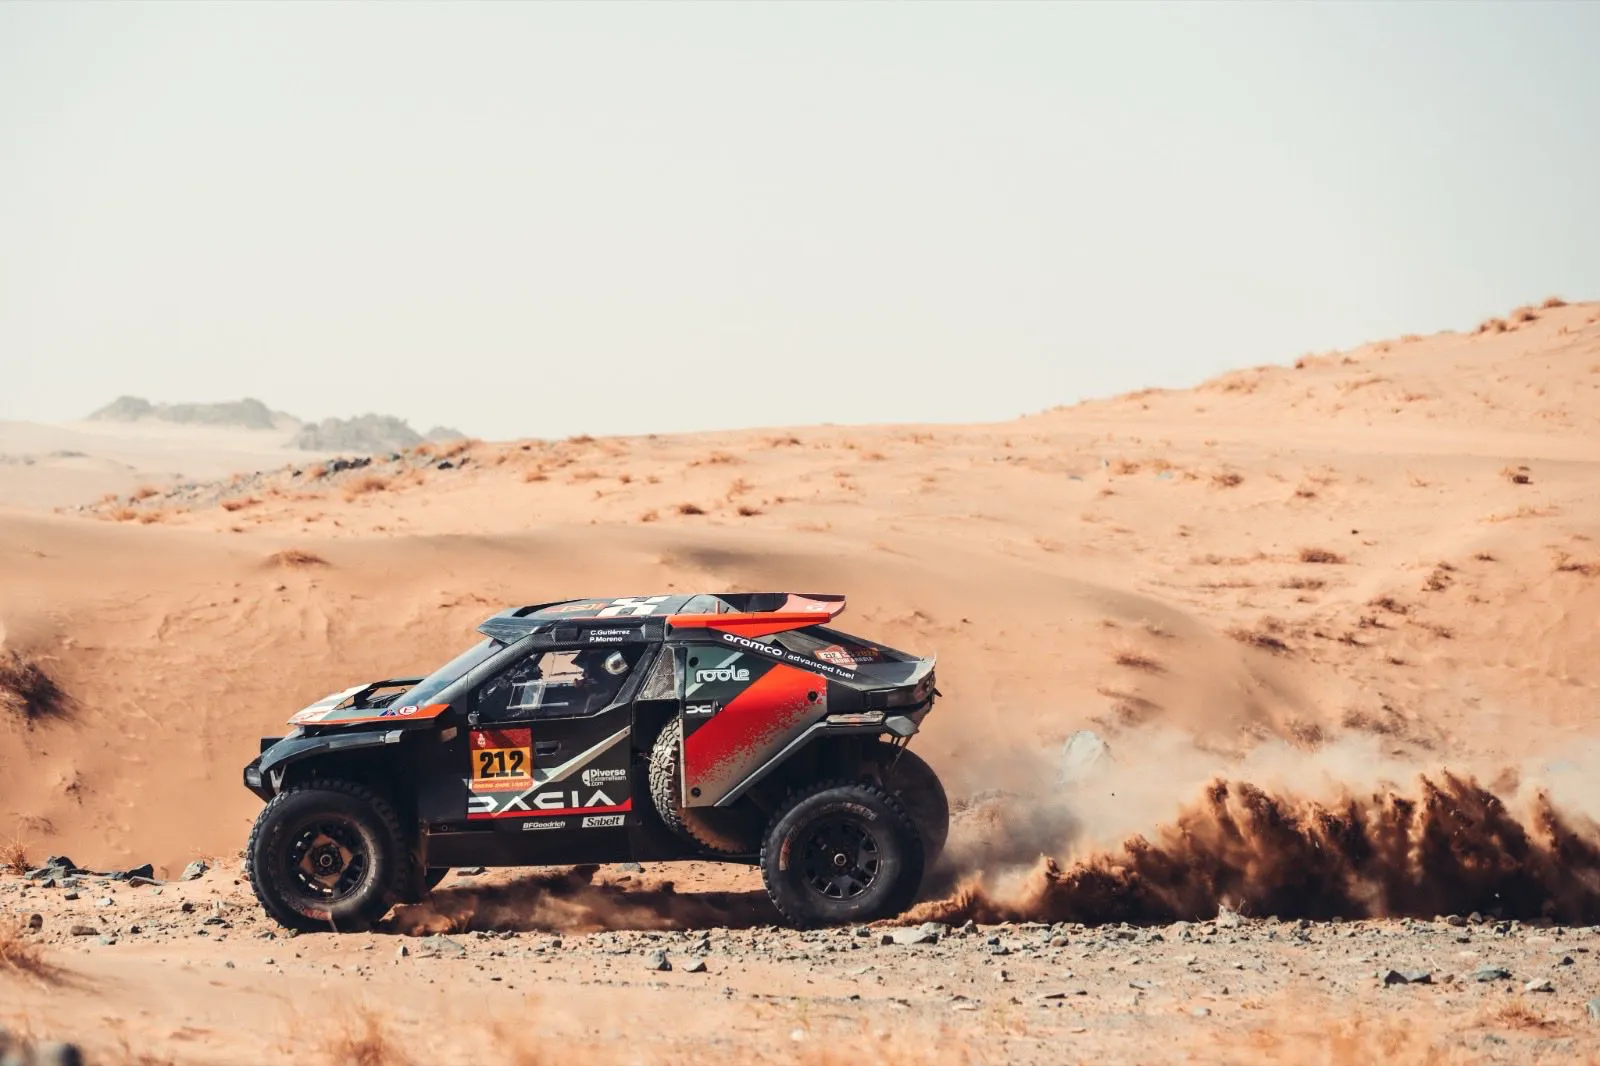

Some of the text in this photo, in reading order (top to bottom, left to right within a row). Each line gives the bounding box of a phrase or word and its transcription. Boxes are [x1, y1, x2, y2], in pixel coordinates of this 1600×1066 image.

[722, 633, 855, 680] aramco advanced fuel
[695, 664, 750, 683] roole
[479, 750, 525, 779] 212
[590, 768, 626, 777] Diverse
[468, 789, 616, 813] DACIA
[522, 820, 566, 829] BFGoodrich
[586, 816, 621, 827] Sabelt
